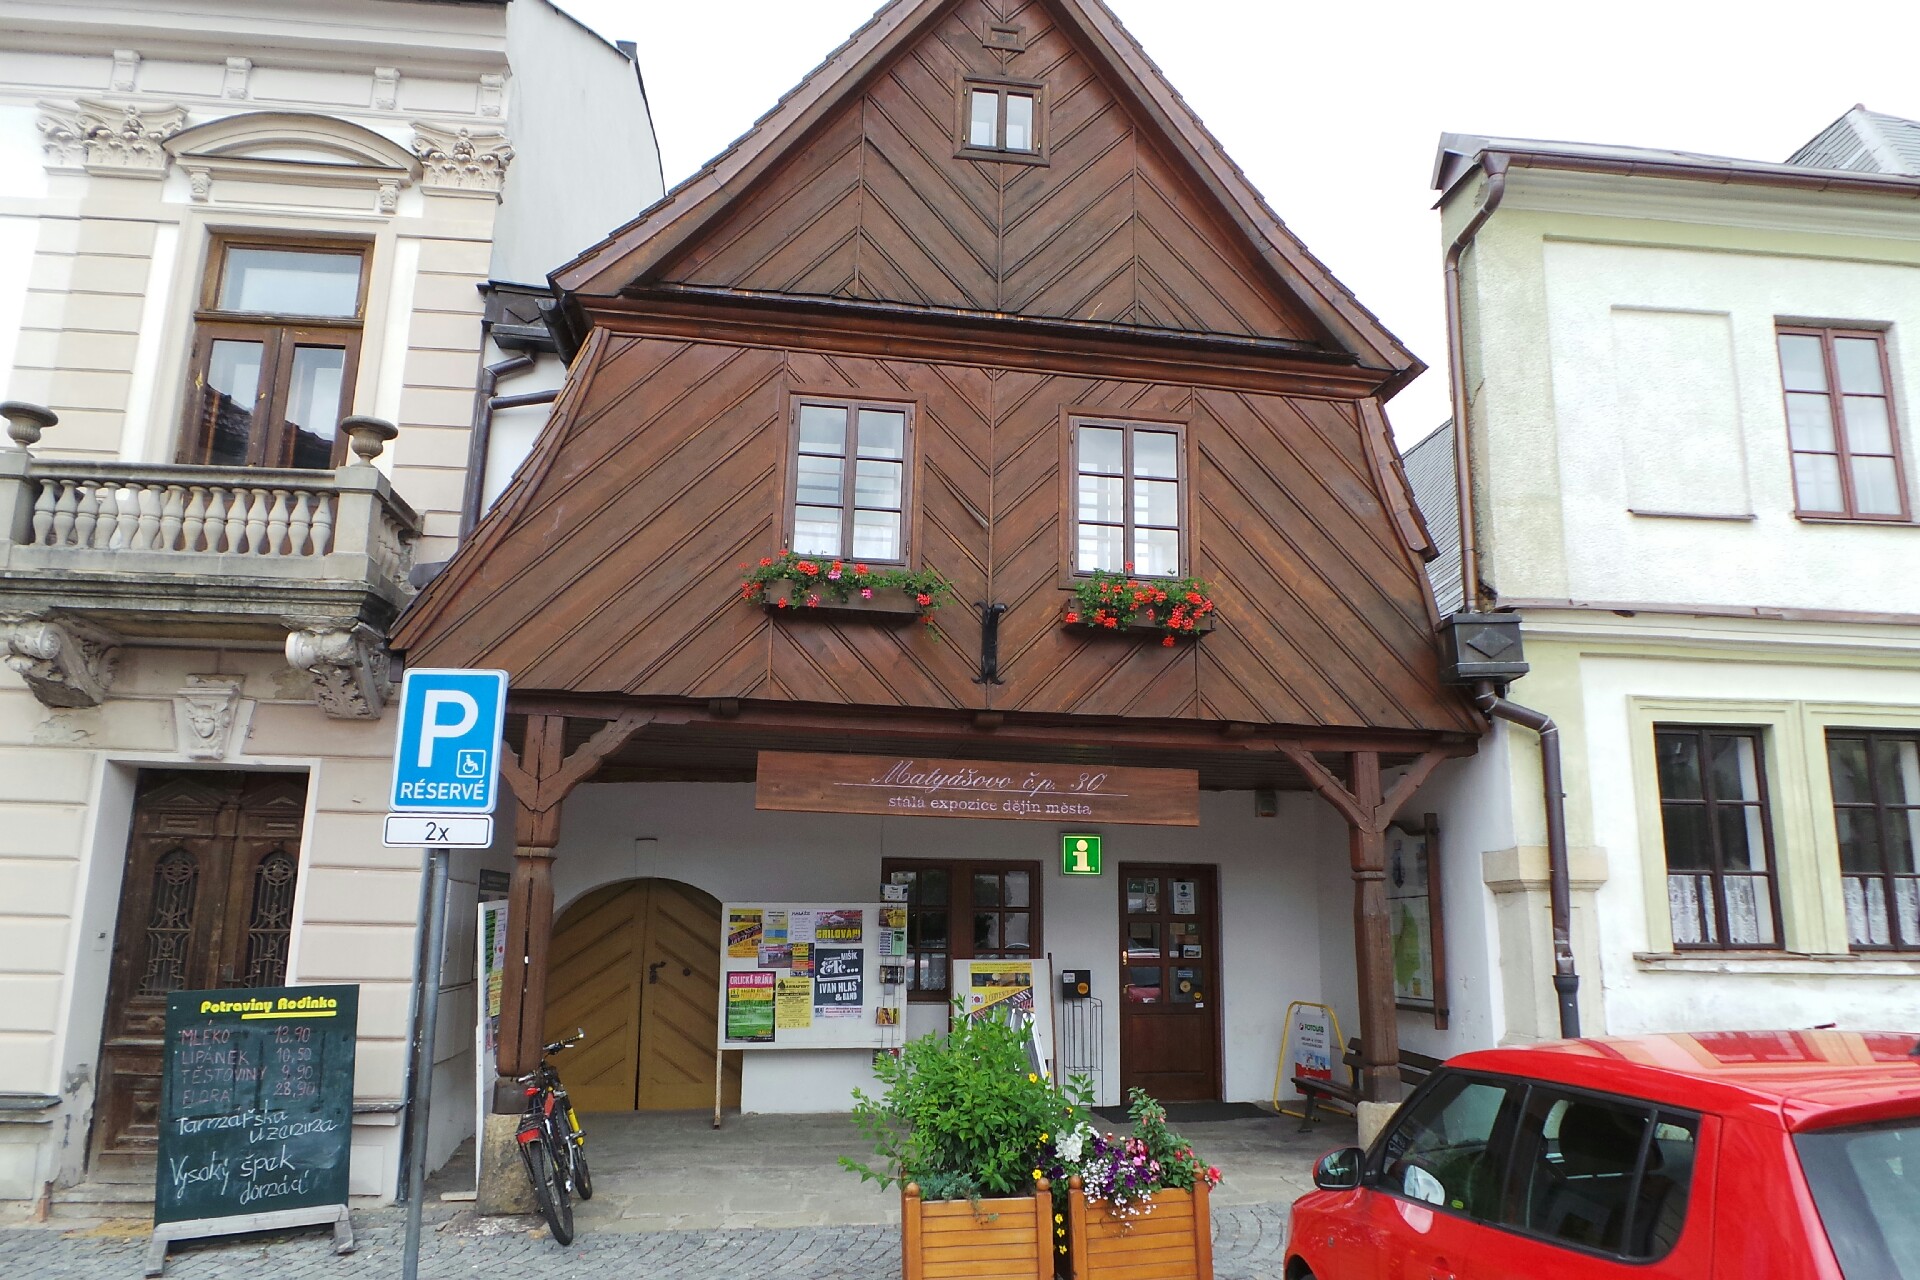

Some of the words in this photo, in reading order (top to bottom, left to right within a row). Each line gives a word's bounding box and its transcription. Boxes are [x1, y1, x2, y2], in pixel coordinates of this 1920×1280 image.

[417, 689, 479, 768] P
[871, 760, 1014, 793] Matyášovo
[1070, 772, 1108, 792] 30
[400, 778, 485, 800] RÉSERVÉ
[888, 795, 925, 808] stálá
[930, 798, 998, 815] expozice
[1002, 799, 1041, 815] dějin
[1045, 801, 1092, 815] města
[424, 821, 450, 842] 2x
[819, 982, 837, 994] IVAN
[838, 981, 857, 993] HLAS
[842, 992, 858, 1001] BAND
[201, 998, 273, 1014] Potraviny
[278, 996, 337, 1010] Rodinka
[181, 1020, 230, 1046] MLÉKO
[182, 1047, 250, 1065] LIPÁNEK
[181, 1066, 267, 1084] TĚSTOVINY
[250, 1117, 339, 1144] uzenina
[170, 1151, 230, 1199] Vysoký
[240, 1170, 310, 1205] domácí
